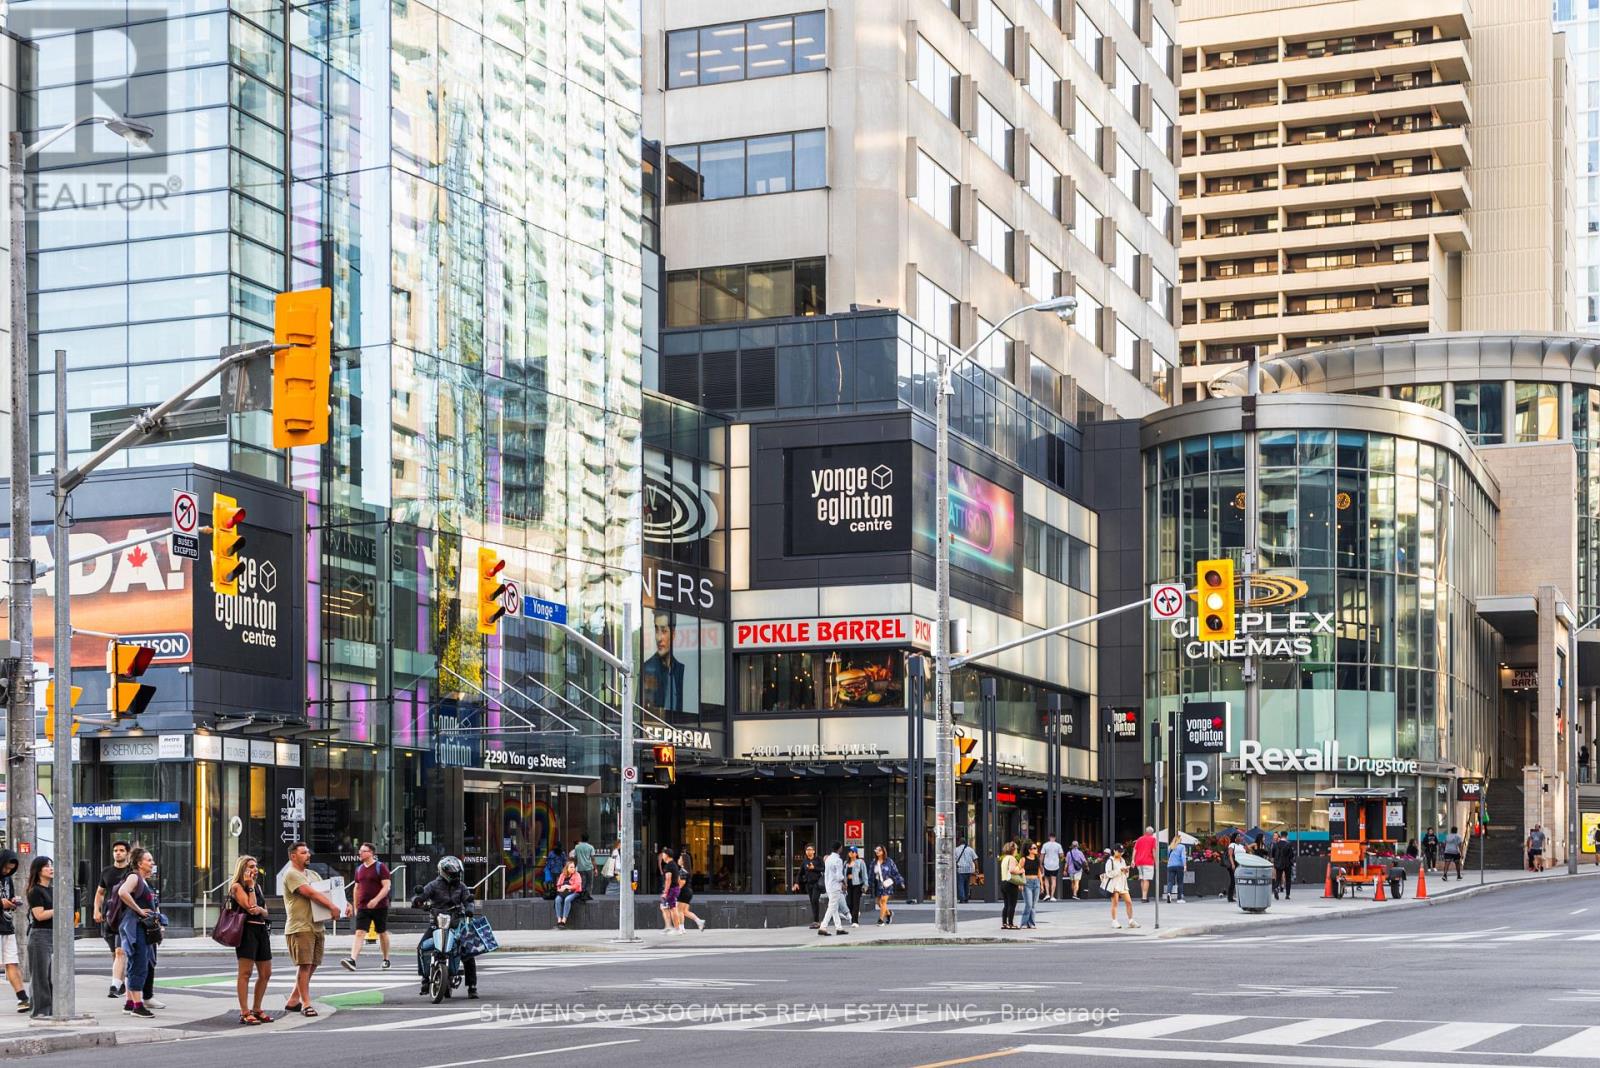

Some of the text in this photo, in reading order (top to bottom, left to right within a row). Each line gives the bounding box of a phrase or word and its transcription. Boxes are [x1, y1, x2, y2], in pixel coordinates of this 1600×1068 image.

[811, 466, 868, 498] yonge
[818, 492, 892, 526] eglinton
[850, 518, 892, 532] centre
[173, 546, 198, 557] EXCEPTED
[177, 538, 194, 548] BUSES
[324, 530, 402, 566] WINNES
[215, 592, 276, 630] eglinton
[532, 600, 554, 620] Yonge
[738, 619, 906, 644] PICKLE BARREL
[1171, 612, 1334, 638] CIPLEX
[242, 630, 276, 648] centre
[1186, 638, 1312, 658] CINEMAS
[1186, 718, 1212, 732] yonge
[645, 726, 712, 750] SEPHORA
[1189, 730, 1223, 744] eglinton
[112, 743, 154, 756] SERVICES
[485, 750, 508, 764] 2290
[540, 754, 566, 768] Street
[750, 743, 878, 757] 2300 YONGE TOWER
[1240, 740, 1418, 776] Rexall Drugstore
[1186, 760, 1208, 792] P
[1462, 784, 1480, 794] VIP
[94, 804, 122, 818] eglinton
